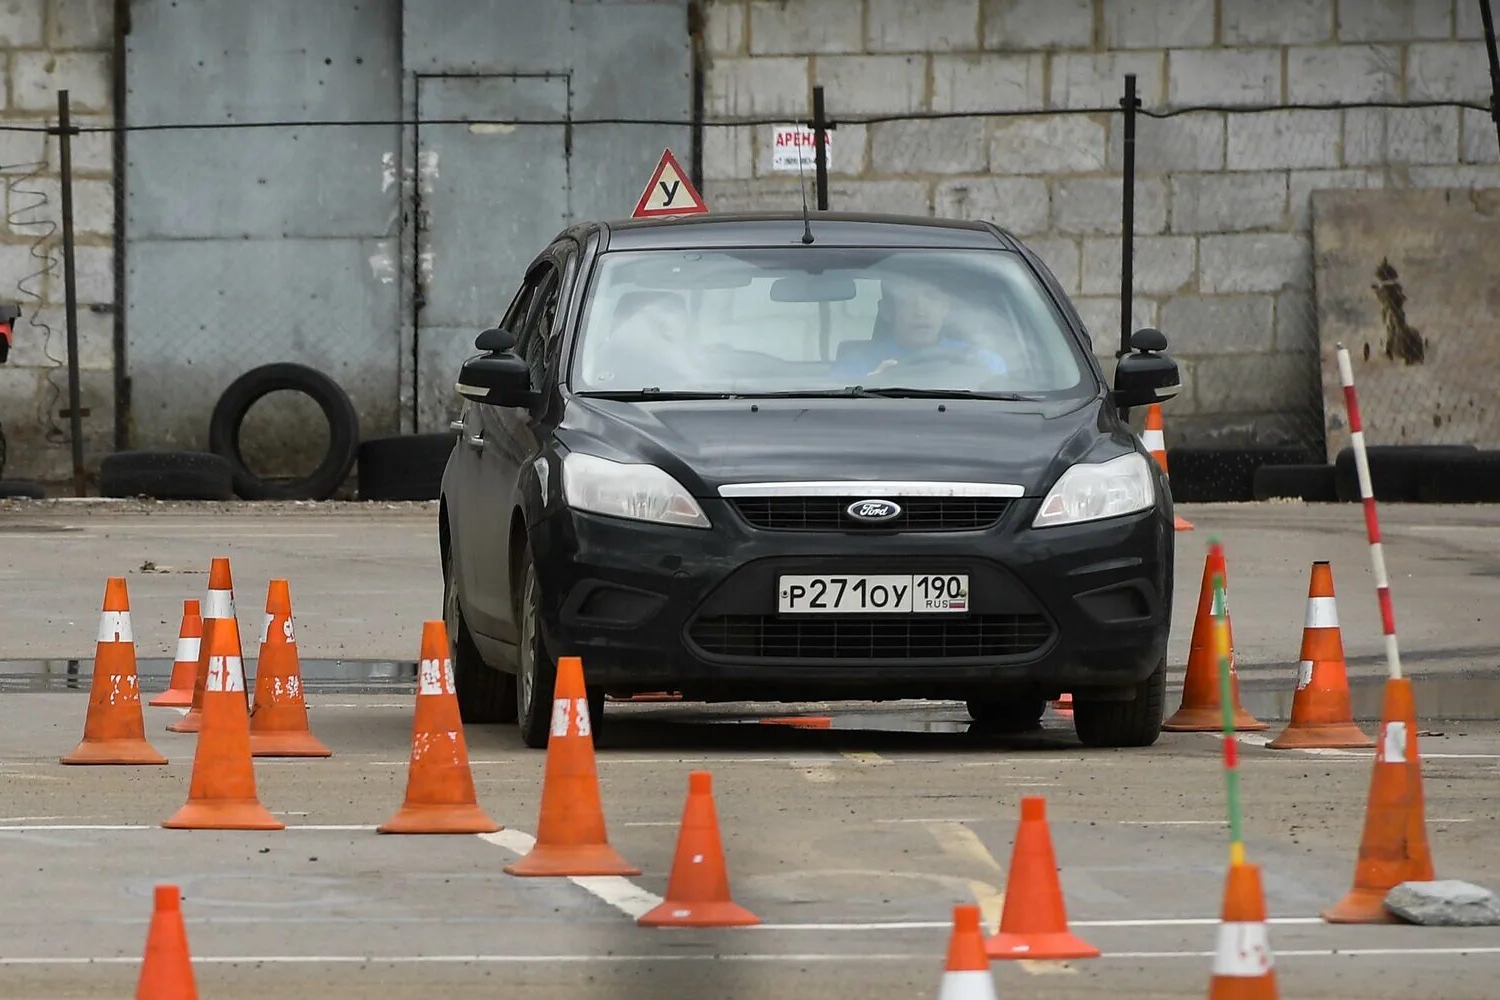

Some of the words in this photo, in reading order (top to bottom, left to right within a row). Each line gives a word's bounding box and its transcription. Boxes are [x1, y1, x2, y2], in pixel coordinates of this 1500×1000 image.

[659, 180, 680, 206] У
[859, 503, 889, 516] Ford
[789, 578, 908, 608] Р271ОУ
[916, 576, 961, 599] 190
[925, 600, 948, 608] RUS
